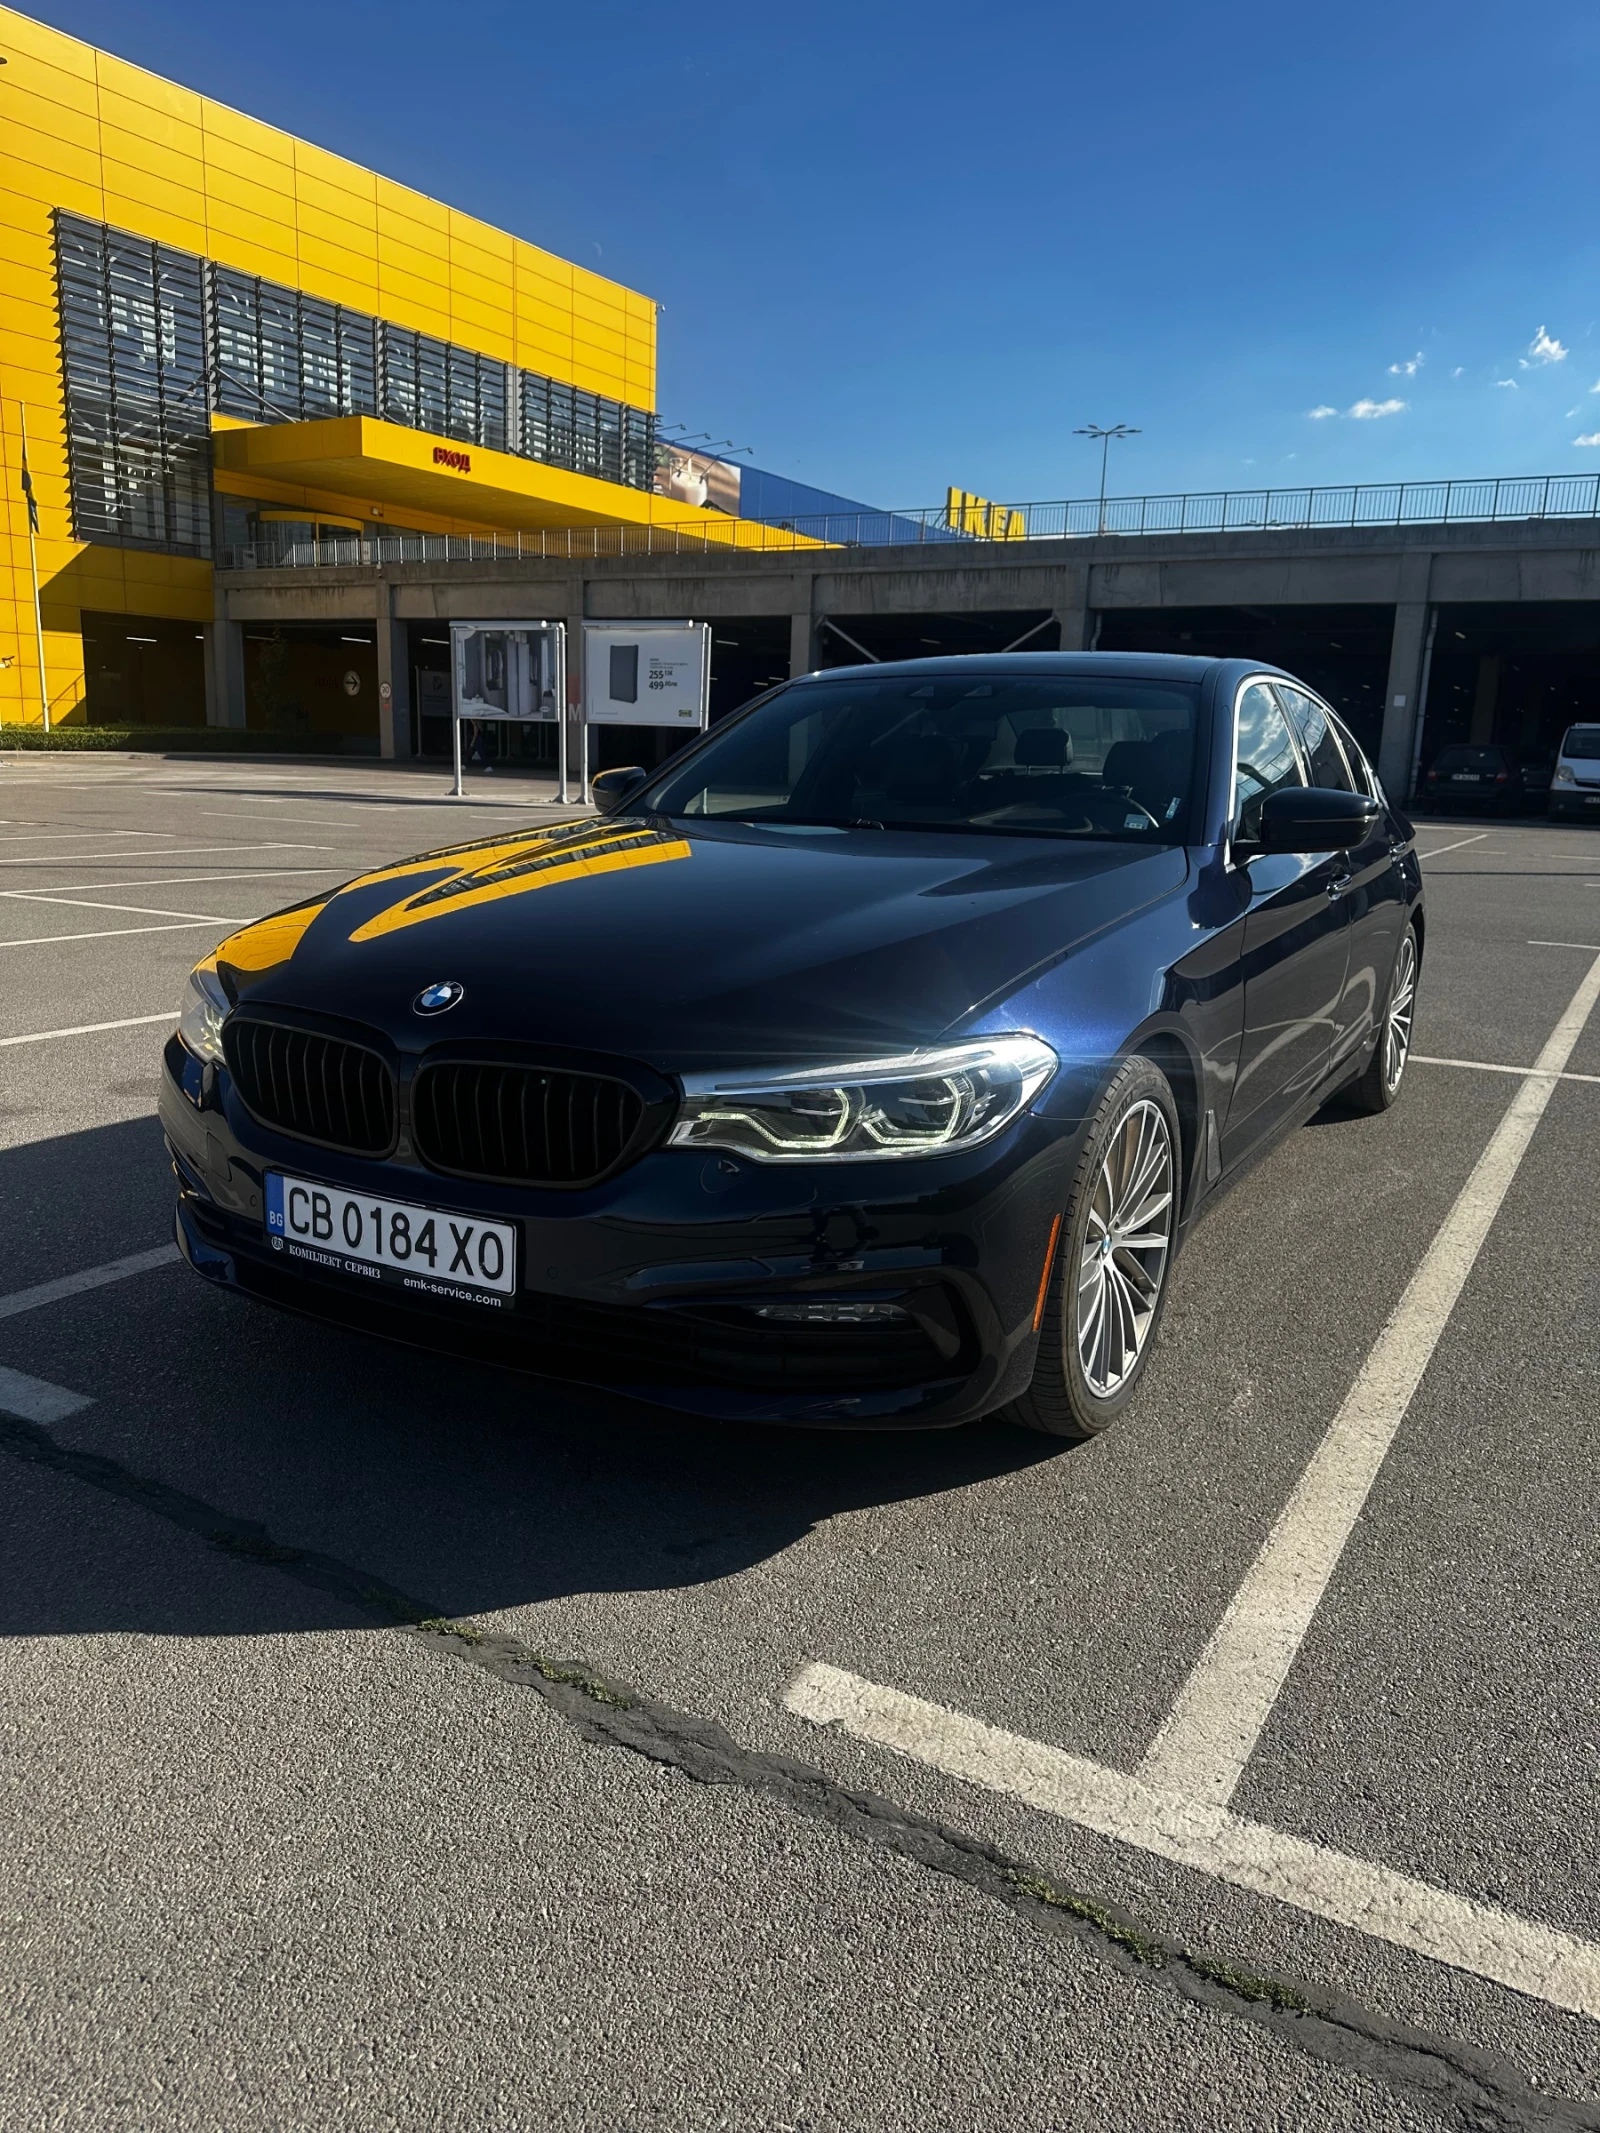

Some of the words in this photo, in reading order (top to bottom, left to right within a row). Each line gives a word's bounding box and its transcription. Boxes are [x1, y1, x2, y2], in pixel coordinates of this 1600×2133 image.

[433, 447, 471, 474] ВХОД
[947, 486, 1025, 541] IKEA
[649, 670, 664, 679] 255
[649, 681, 664, 690] 499
[269, 1210, 283, 1227] BG
[289, 1186, 333, 1241] CB
[342, 1201, 438, 1268] 0184
[289, 1244, 341, 1269] КОМПЛЕКТ
[345, 1260, 381, 1279] СЕРВИЗ
[403, 1277, 502, 1307] emk-service.com
